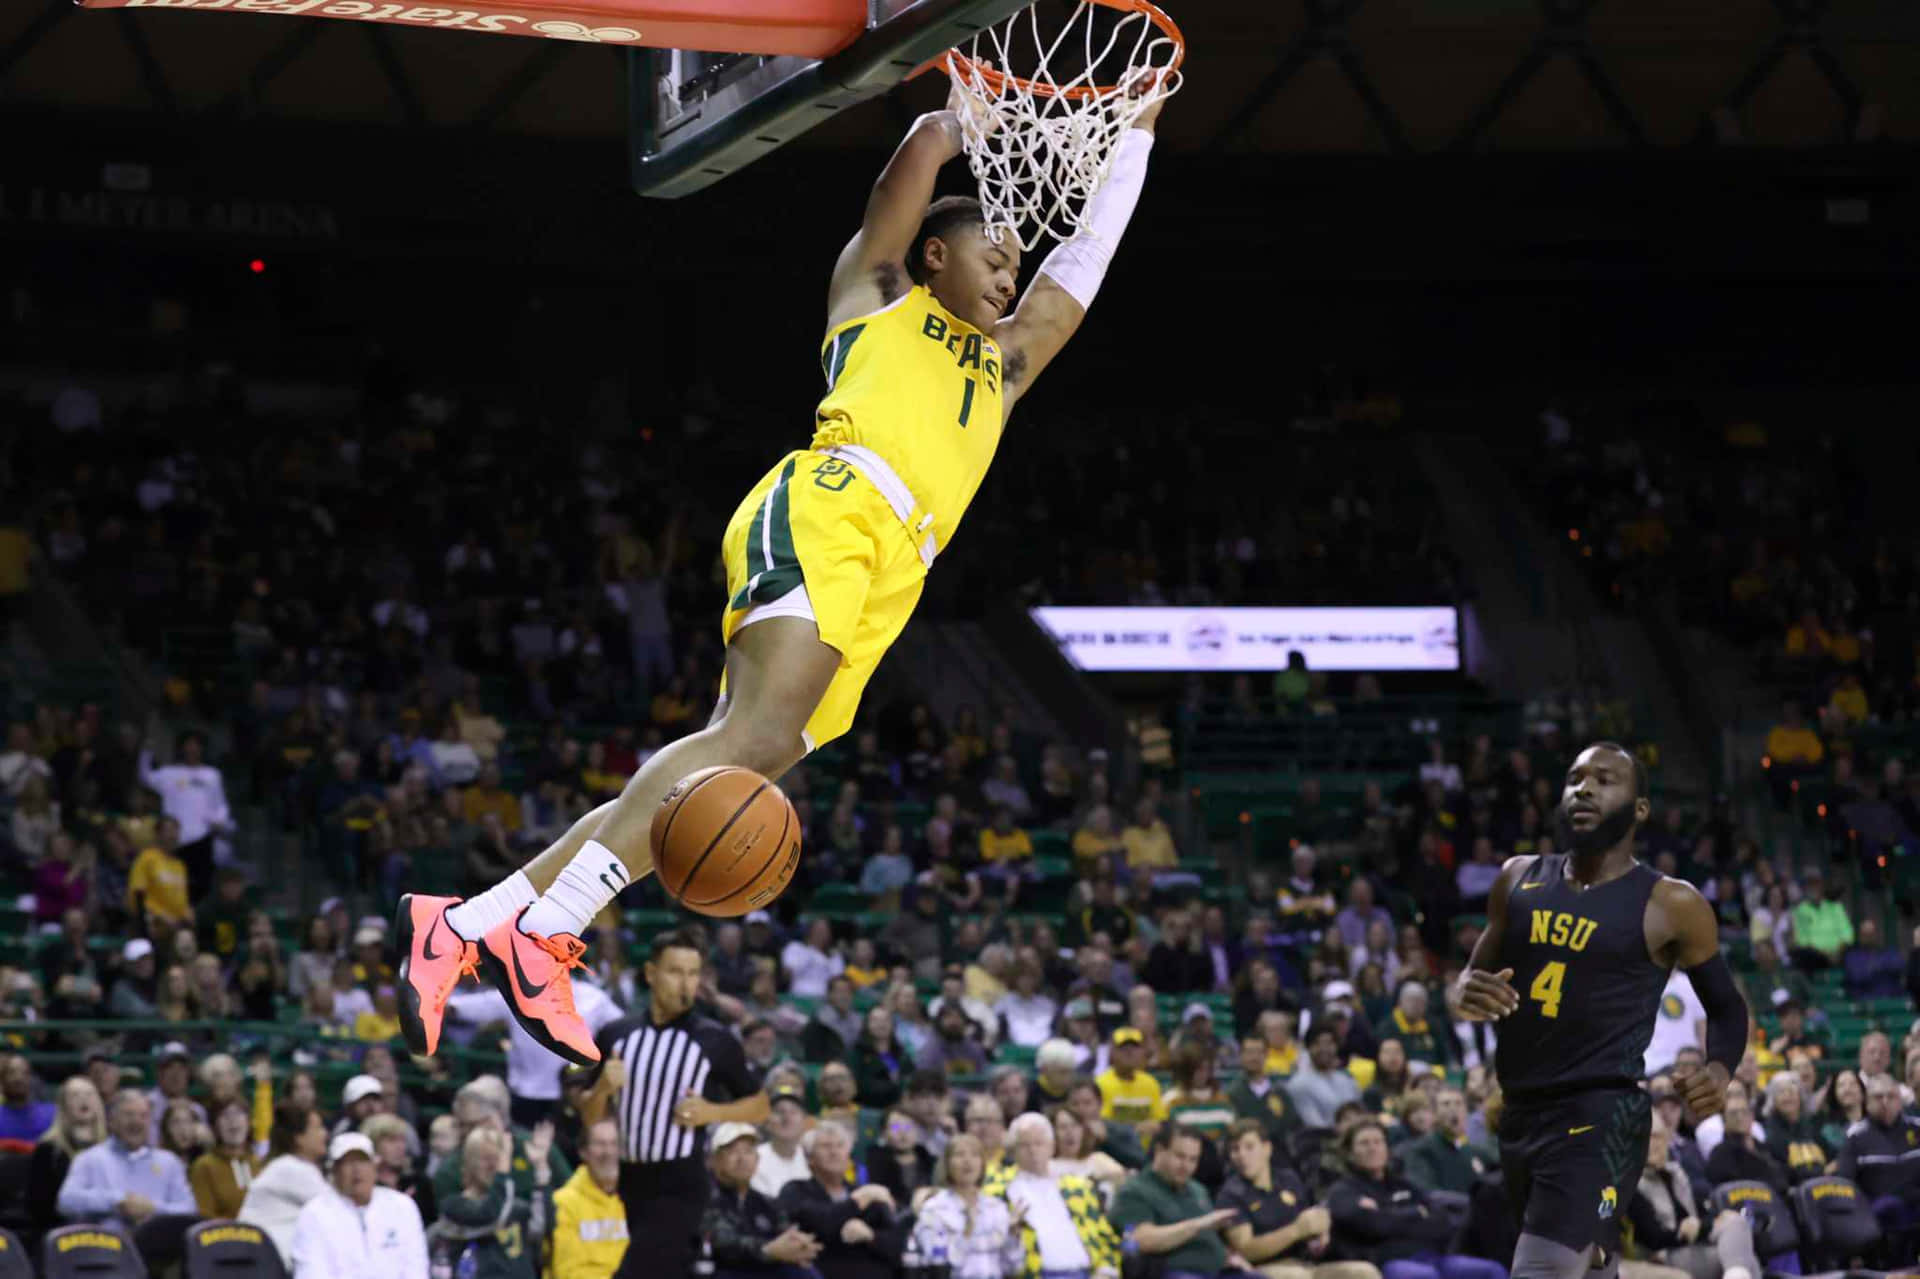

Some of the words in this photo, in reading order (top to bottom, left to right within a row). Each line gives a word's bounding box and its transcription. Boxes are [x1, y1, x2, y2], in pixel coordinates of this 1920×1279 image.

[321, 1, 529, 33] State
[958, 377, 975, 428] 1
[1529, 909, 1598, 952] NSU
[1530, 961, 1566, 1018] 4
